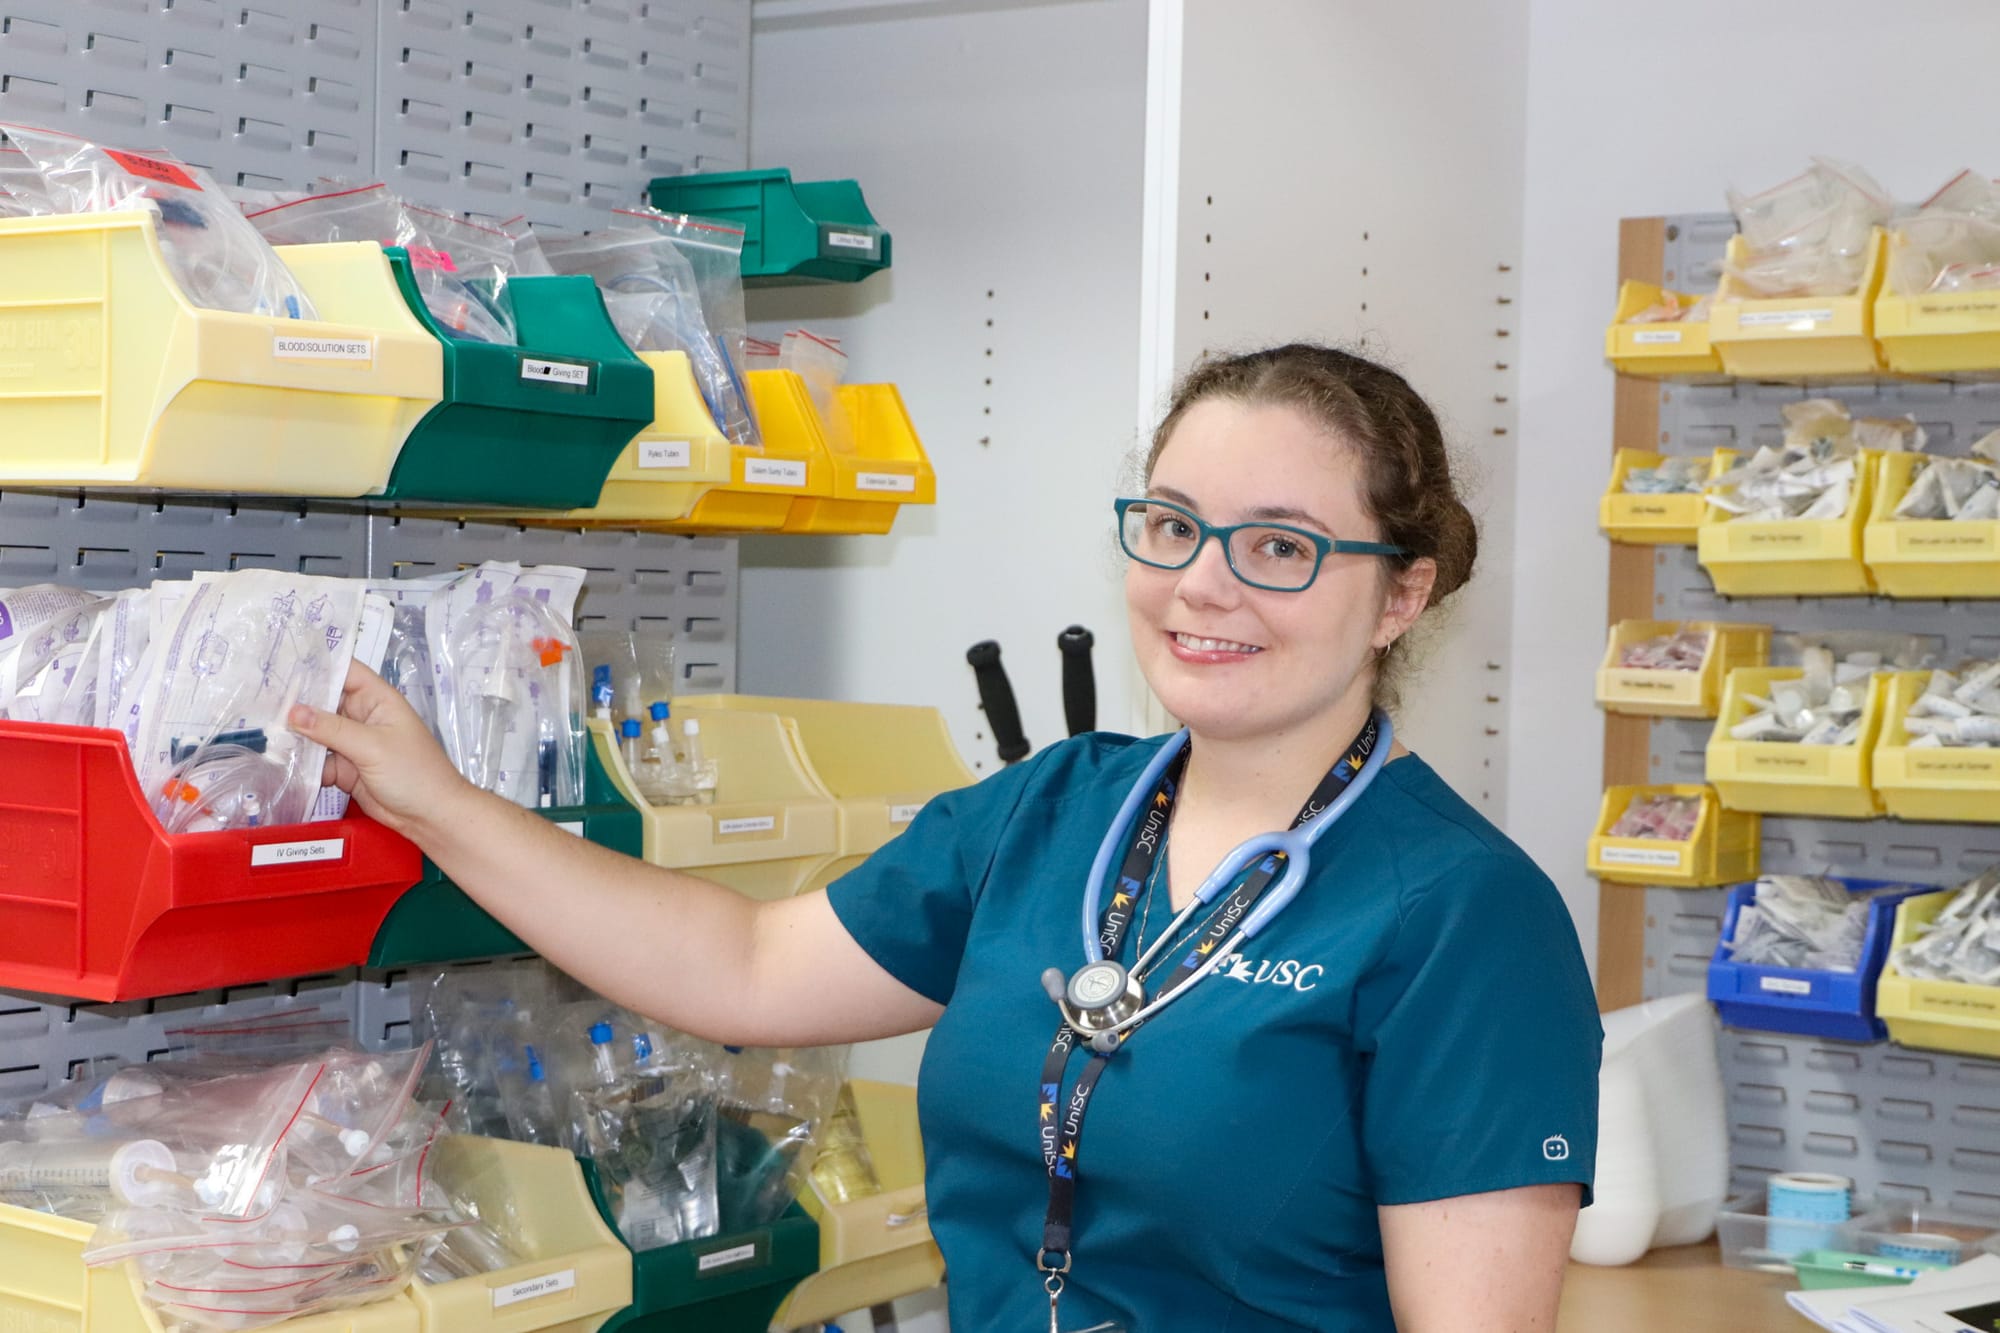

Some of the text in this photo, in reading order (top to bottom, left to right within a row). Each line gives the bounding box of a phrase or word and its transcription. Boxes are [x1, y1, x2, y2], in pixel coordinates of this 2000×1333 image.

[346, 344, 367, 355] SETS
[552, 368, 571, 380] Giving
[572, 370, 585, 380] SET
[1136, 810, 1165, 855] UniSC
[276, 845, 326, 858] IV Giving Sets
[1210, 895, 1250, 938] UniSC
[1253, 959, 1324, 992] USC
[1064, 1083, 1089, 1136] UniSC
[546, 1279, 559, 1287] Sets
